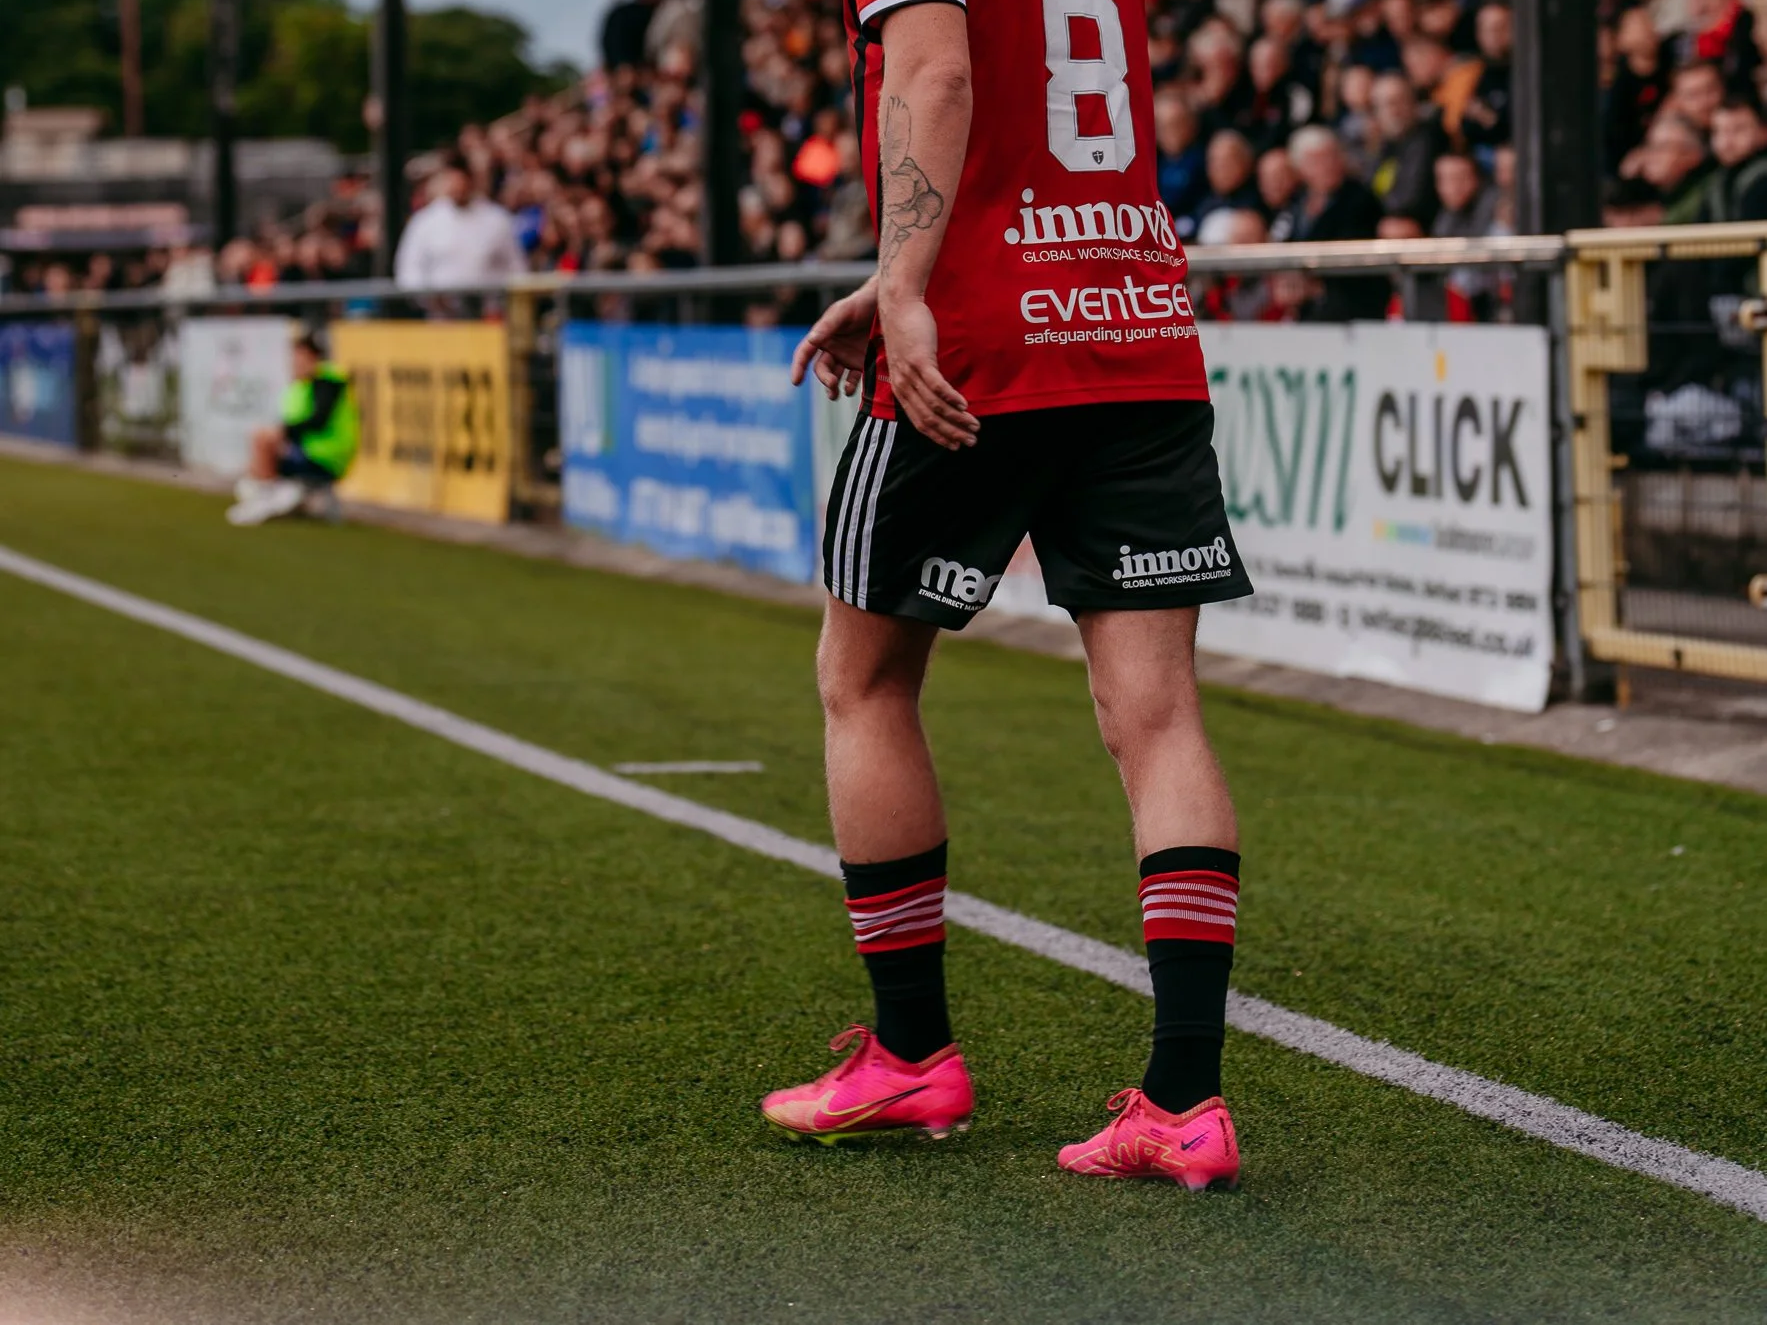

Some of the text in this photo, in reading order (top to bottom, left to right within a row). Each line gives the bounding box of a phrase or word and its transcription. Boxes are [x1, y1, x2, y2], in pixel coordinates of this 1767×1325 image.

[1022, 249, 1076, 263] GLOBAL
[1077, 247, 1143, 261] WORKSPACE
[1025, 326, 1122, 345] safeguarding
[1126, 327, 1158, 343] your
[1122, 568, 1232, 589] GLOBAL WORKSPACE SOLUTIONS
[918, 588, 942, 602] ETHICAL
[941, 596, 965, 610] DIRECT
